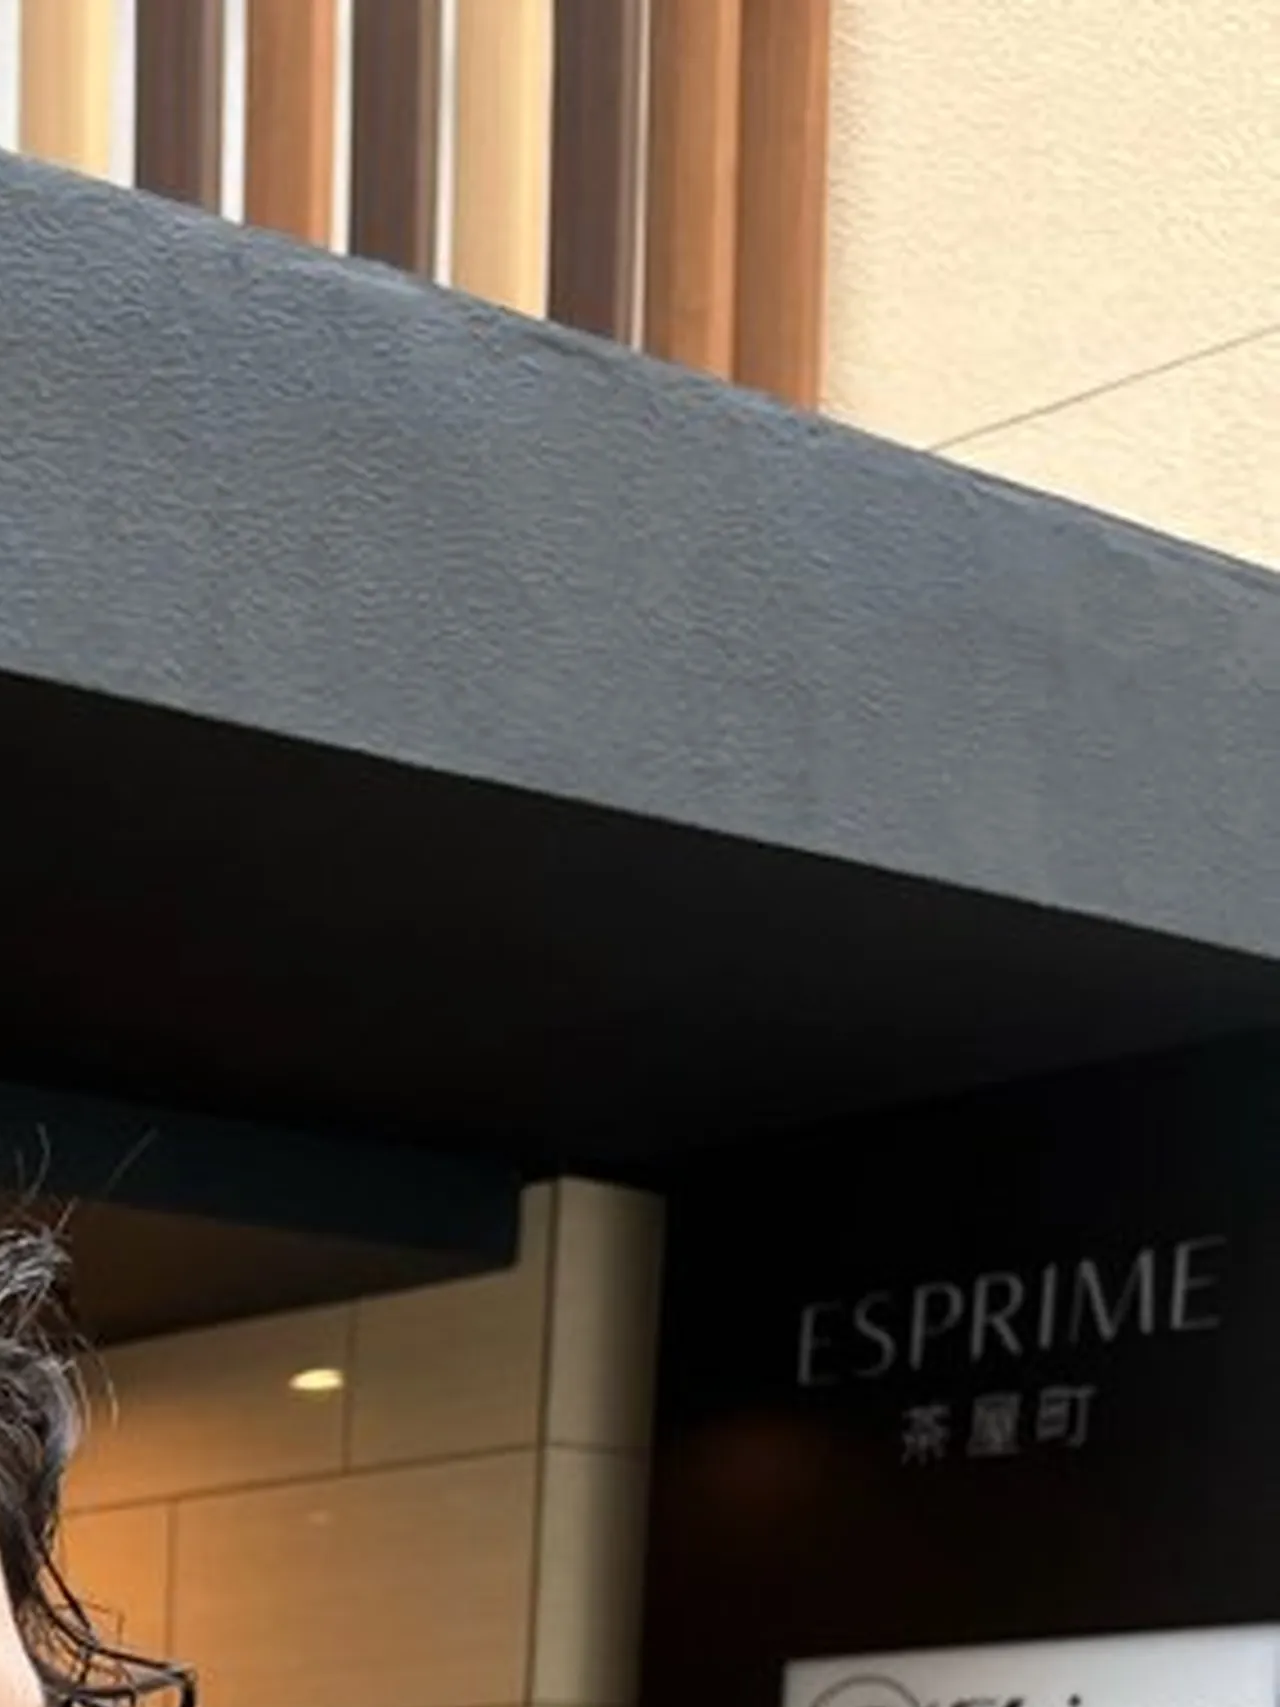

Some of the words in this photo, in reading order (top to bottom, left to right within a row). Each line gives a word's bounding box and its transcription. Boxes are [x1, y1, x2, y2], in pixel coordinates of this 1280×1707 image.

[796, 1234, 1228, 1387] ESPRIME
[900, 1385, 1096, 1465] 茶屋町
